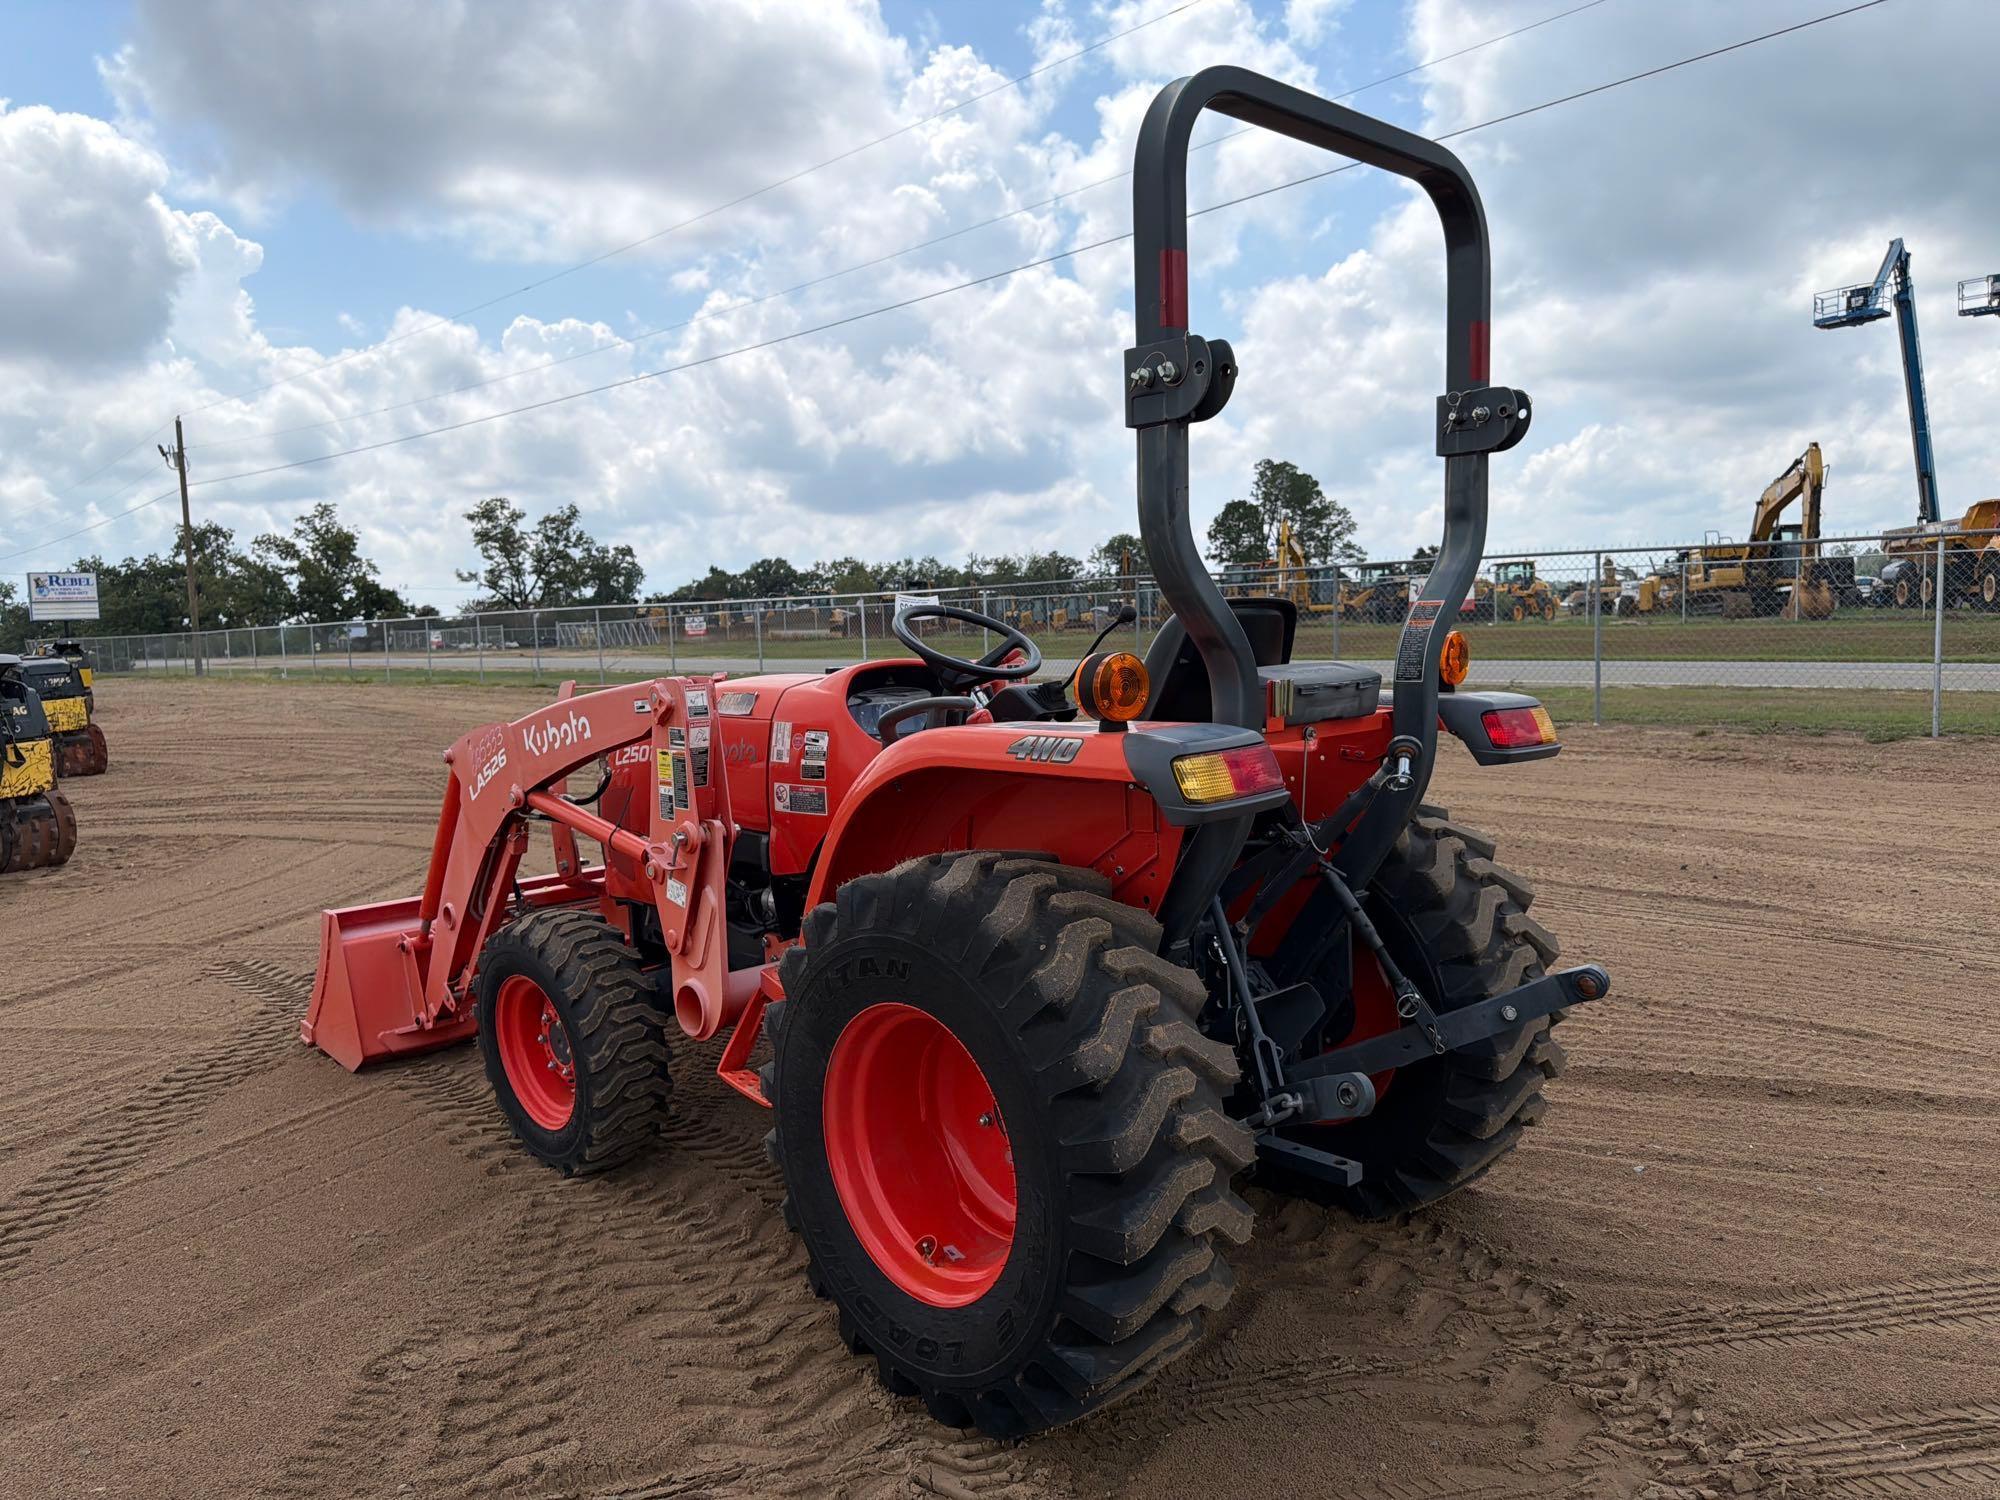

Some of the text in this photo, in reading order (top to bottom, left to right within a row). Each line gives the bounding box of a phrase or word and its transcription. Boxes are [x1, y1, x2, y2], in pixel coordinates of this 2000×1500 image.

[48, 575, 94, 587] REBEL
[523, 710, 591, 756] Kubota
[615, 744, 653, 766] L250
[1006, 734, 1084, 764] 4WD
[469, 747, 507, 801] LA526
